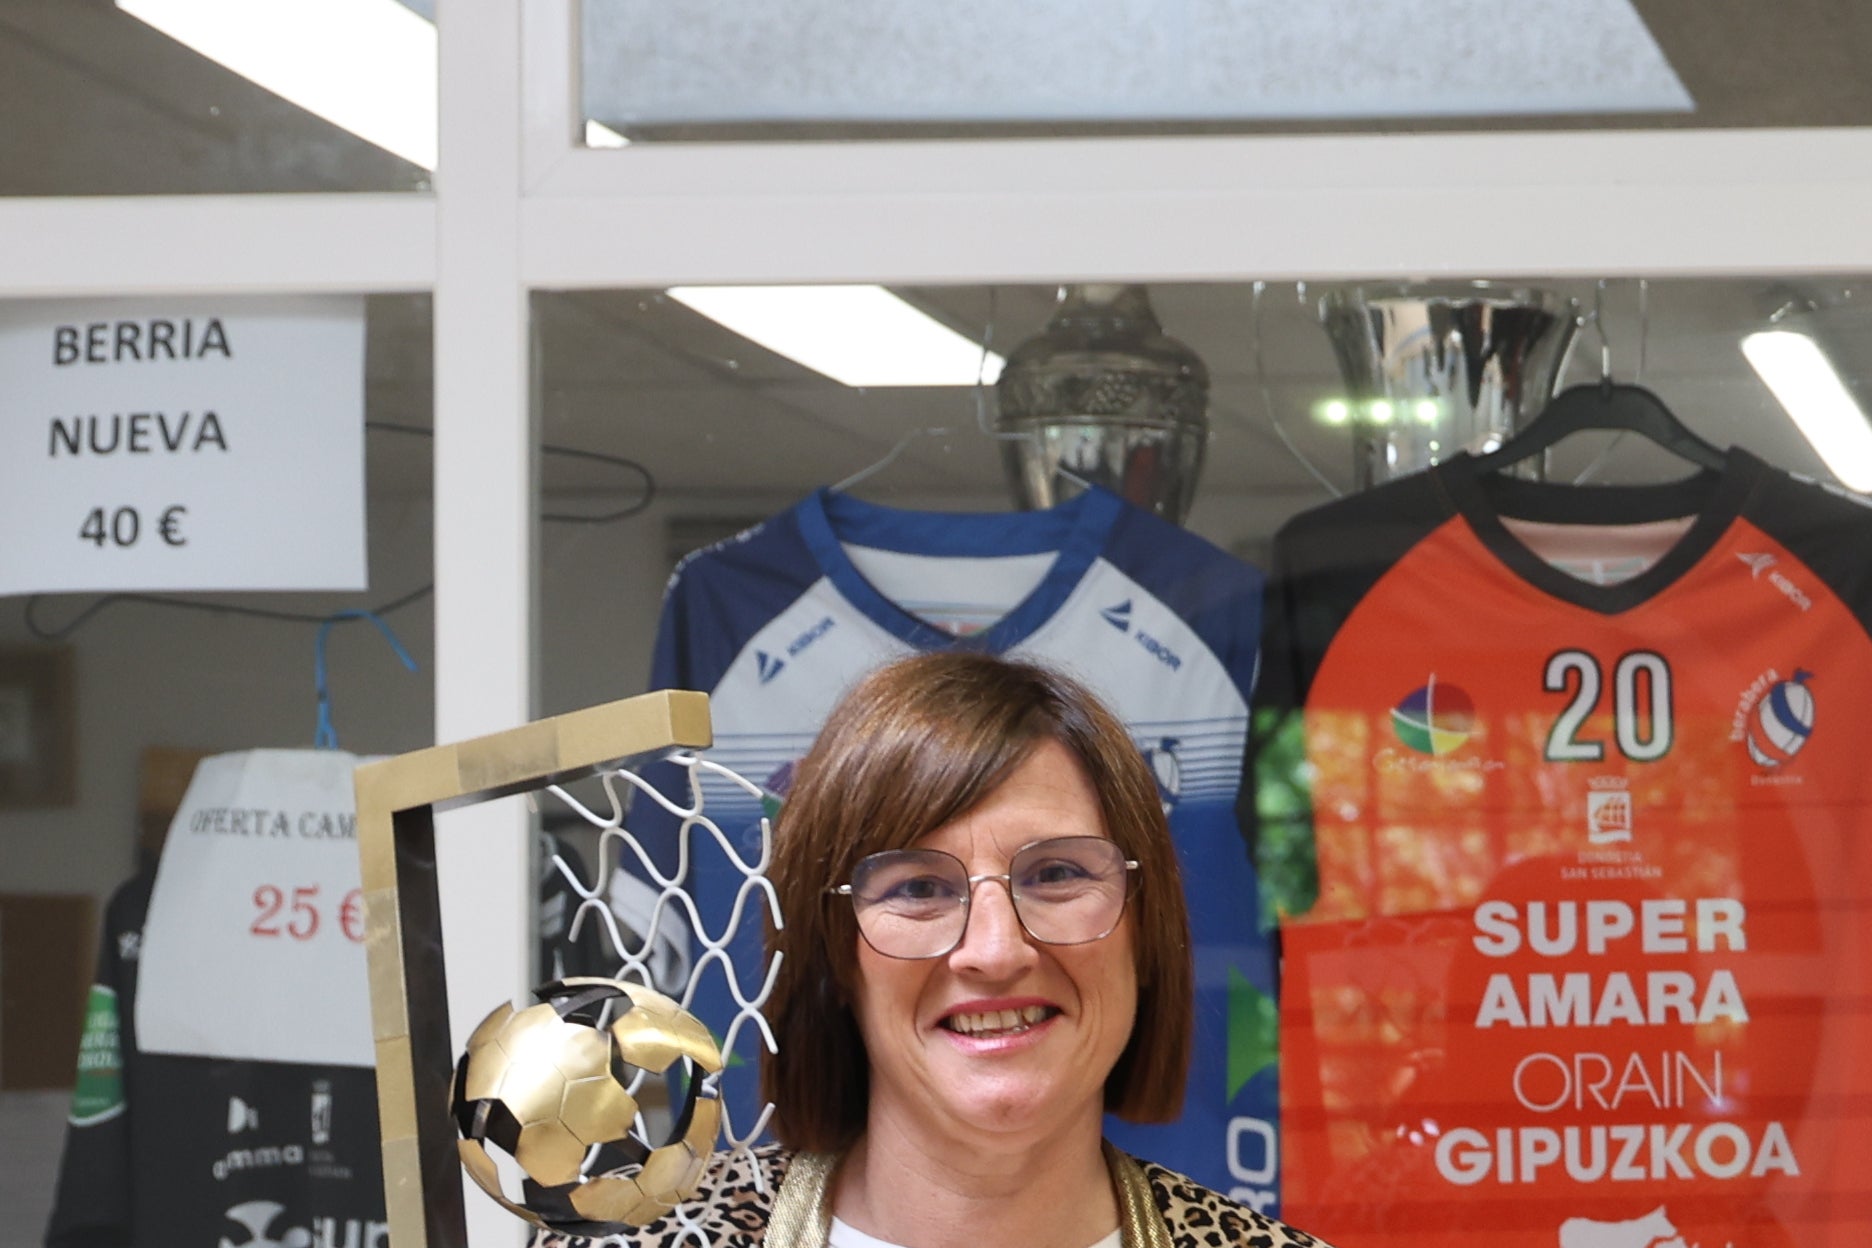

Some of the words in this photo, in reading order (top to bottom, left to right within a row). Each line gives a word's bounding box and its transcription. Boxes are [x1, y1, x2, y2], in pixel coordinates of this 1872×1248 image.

[53, 317, 234, 366] BERRIA
[48, 411, 229, 458] NUEVA
[80, 506, 140, 548] 40
[158, 505, 189, 547] €
[1768, 571, 1812, 611] KIBOR
[787, 616, 836, 657] KIBOR
[1135, 629, 1182, 672] KIBOR
[1543, 647, 1674, 763] 20
[189, 807, 290, 837] OFERTA
[250, 883, 321, 941] 25
[1472, 898, 1747, 957] SUPER
[1474, 969, 1750, 1028] AMARA
[1513, 1049, 1723, 1113] ORAIN
[1434, 1121, 1800, 1185] GIPUZKOA
